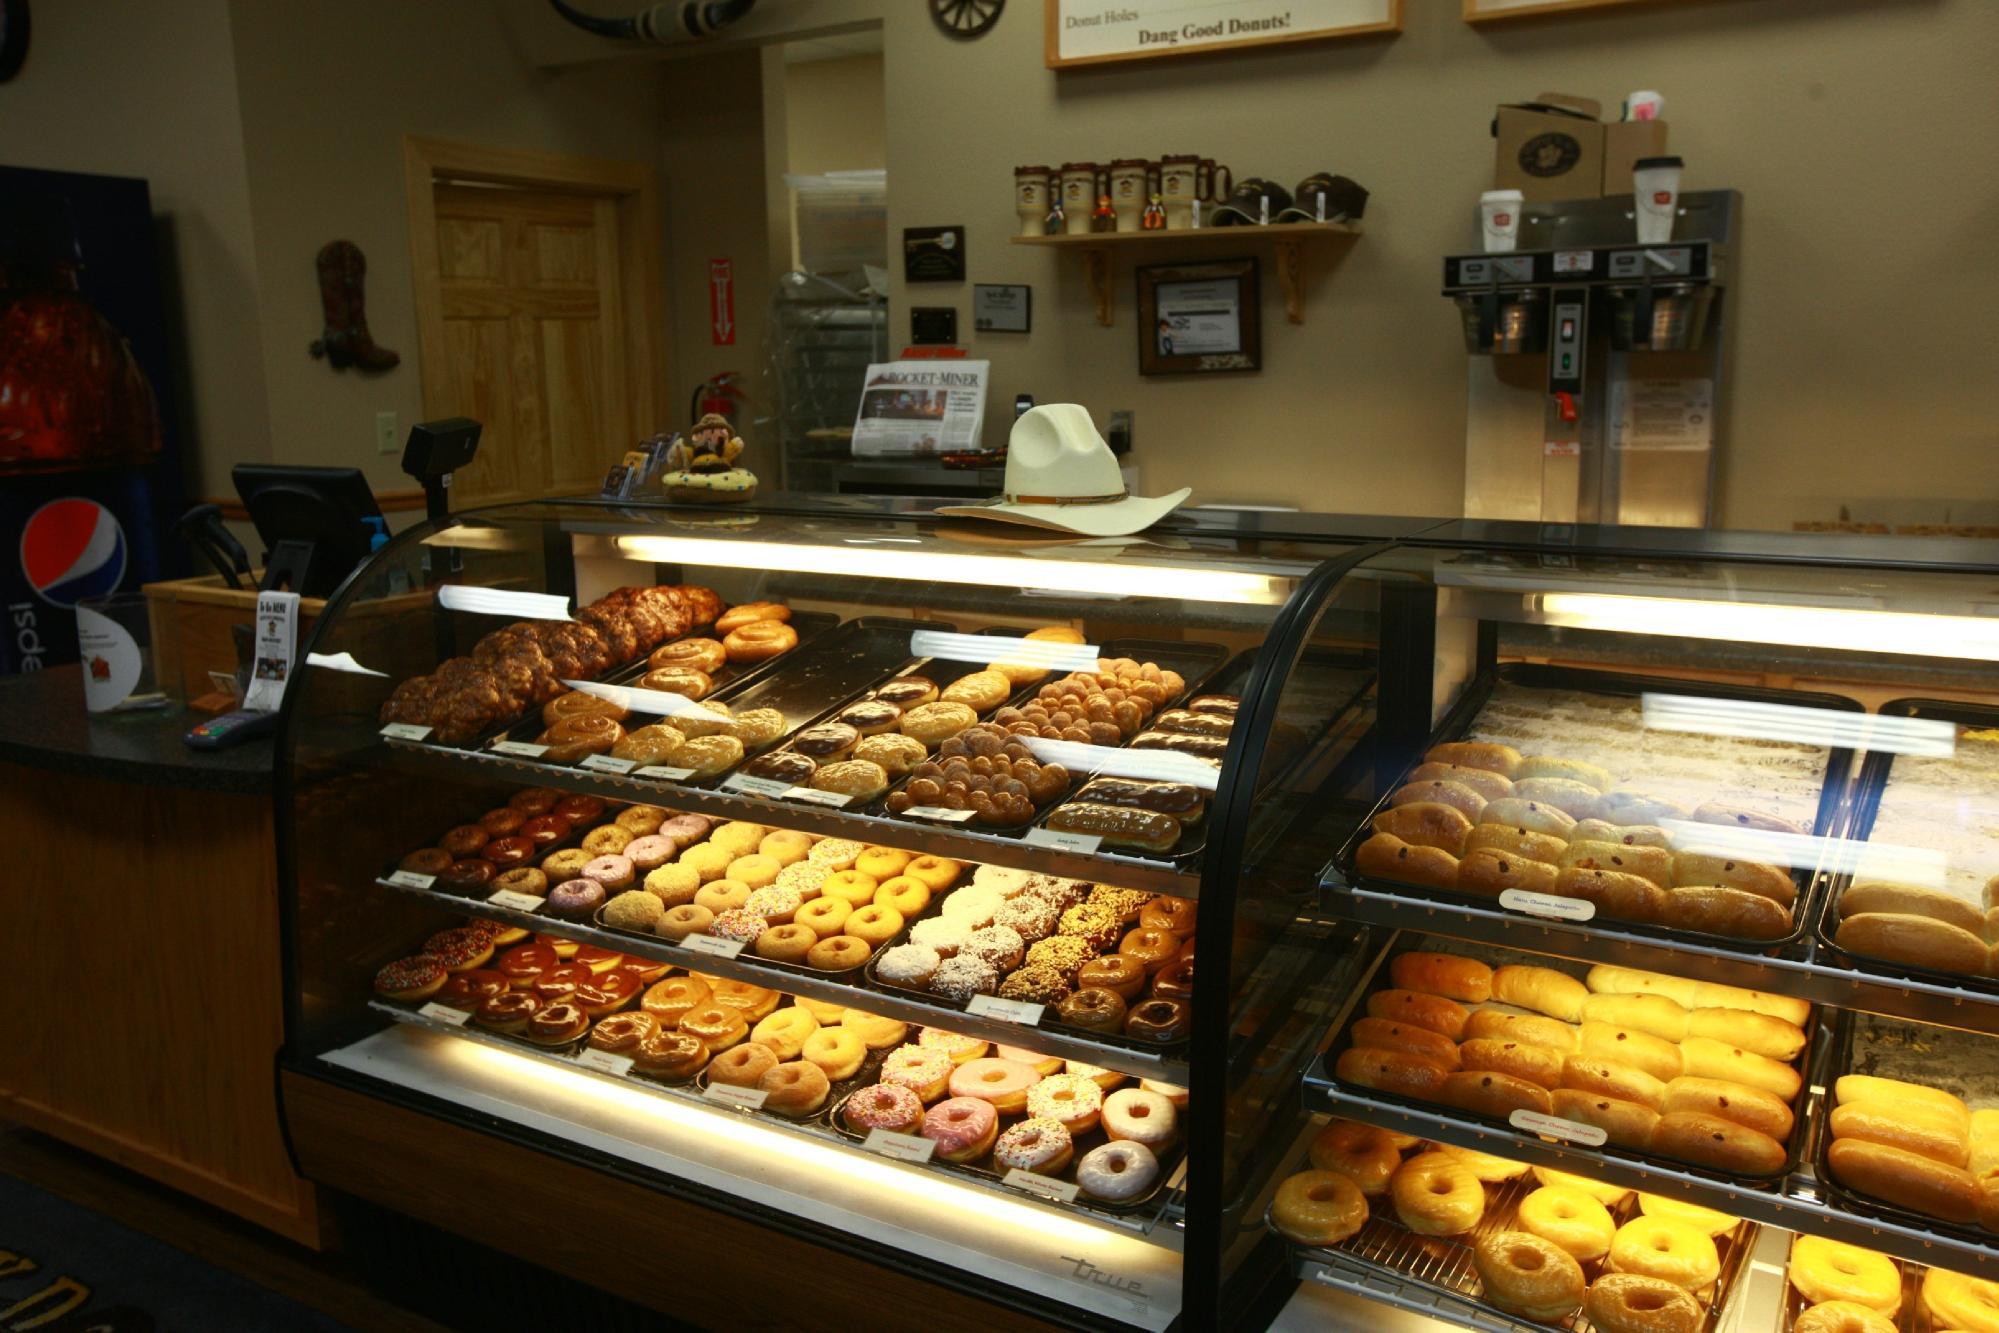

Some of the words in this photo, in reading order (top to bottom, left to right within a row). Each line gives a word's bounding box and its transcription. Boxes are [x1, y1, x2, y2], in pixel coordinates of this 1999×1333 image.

[1065, 15, 1101, 29] Donut
[1104, 9, 1139, 25] Holes
[1138, 29, 1178, 45] Dang
[1182, 20, 1223, 39] Good
[1228, 12, 1291, 34] Donuts!
[888, 370, 978, 386] ROCKET-MINER
[8, 602, 47, 672] epsi
[1060, 1256, 1149, 1299] true
